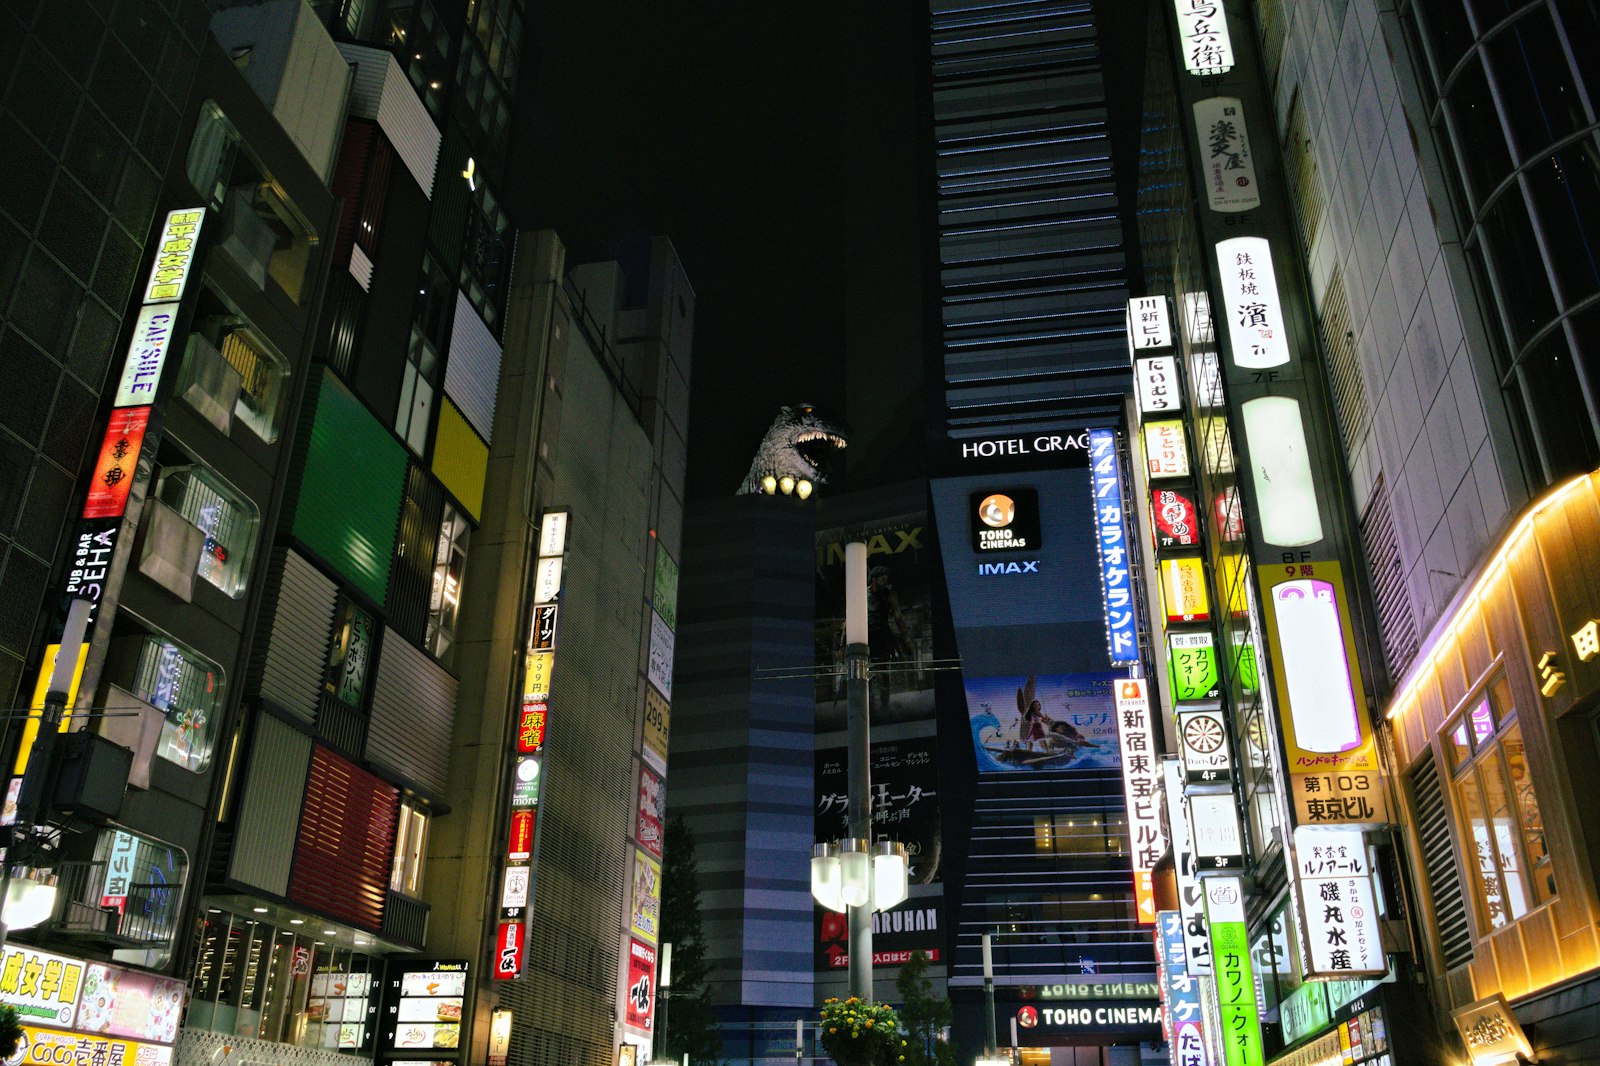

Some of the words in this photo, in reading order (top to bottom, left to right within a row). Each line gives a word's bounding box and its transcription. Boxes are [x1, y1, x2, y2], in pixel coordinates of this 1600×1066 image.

[1236, 253, 1259, 296] 鉄板焼
[1139, 299, 1162, 347] 川新ビル
[131, 315, 171, 394] CAPSULE
[1148, 360, 1178, 409] にいむら
[963, 439, 1030, 458] HOTEL
[1160, 427, 1178, 474] ととりこ
[1092, 436, 1118, 498] 747
[1161, 492, 1187, 535] おすすめ
[980, 529, 1013, 544] TOHO
[980, 539, 1026, 550] CINEMAS
[1162, 538, 1173, 546] 7F
[67, 567, 83, 593] PUB
[76, 533, 93, 557] BAR
[979, 560, 1038, 575] IMAX
[1284, 564, 1315, 577] 9階
[1100, 504, 1133, 653] カラオケランド
[541, 608, 555, 640] ダーツ
[1179, 654, 1196, 698] クォーク
[1208, 690, 1219, 698] 5F
[521, 713, 544, 746] 麻雀
[1188, 758, 1208, 768] Darts
[1209, 754, 1228, 767] UP
[1202, 770, 1216, 780] 4F
[1304, 775, 1370, 793] 第103
[1123, 709, 1160, 869] 新宿東宝ビル店
[512, 796, 538, 806] more
[1306, 796, 1374, 821] 東京ビル
[1214, 856, 1228, 868] 3F
[1313, 845, 1348, 859] 喫茶室
[1304, 858, 1362, 875] ルノアール
[1349, 880, 1359, 903] さかな
[508, 908, 519, 917] 3F
[872, 908, 937, 934] ARUHAN
[1319, 881, 1353, 970] 磯丸水産
[1354, 920, 1369, 969] 加工センター
[1042, 1008, 1092, 1025] TOHO
[56, 1035, 76, 1045] HOUSE
